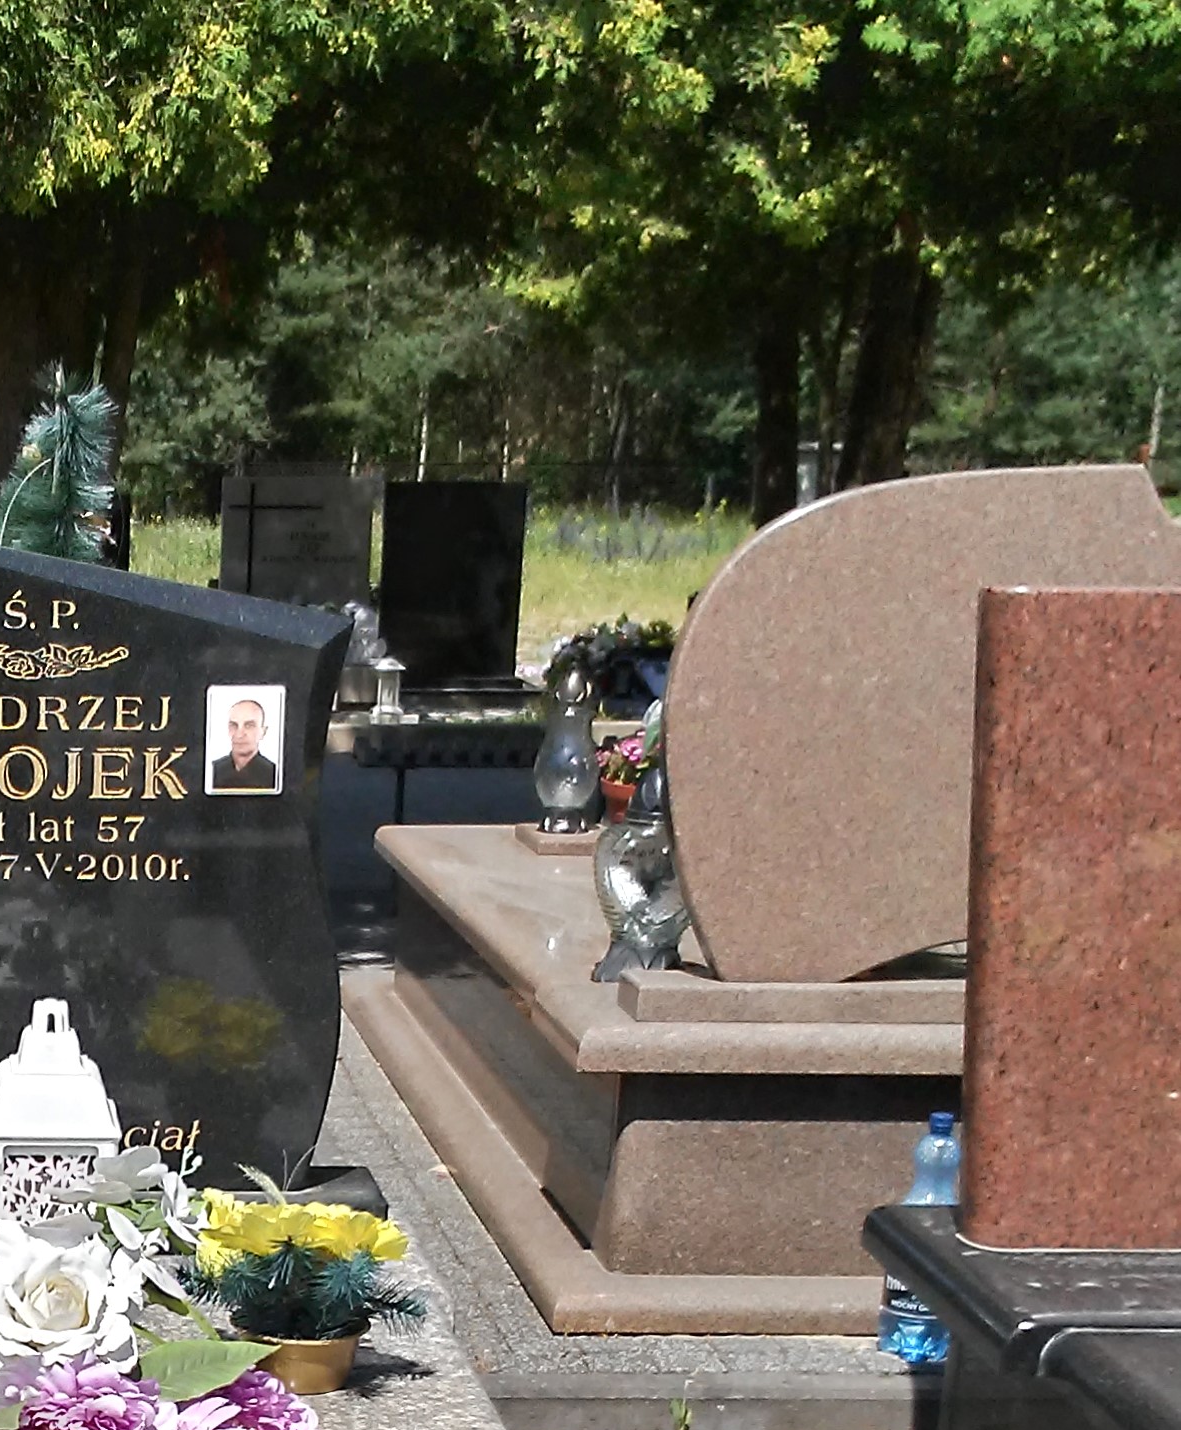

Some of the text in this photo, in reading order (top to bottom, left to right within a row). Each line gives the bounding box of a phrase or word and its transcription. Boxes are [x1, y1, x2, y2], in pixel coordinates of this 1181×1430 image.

[3, 590, 79, 630] Ś. P.
[29, 812, 74, 843] lat
[97, 815, 145, 843] 57
[123, 1119, 201, 1152] ciał
